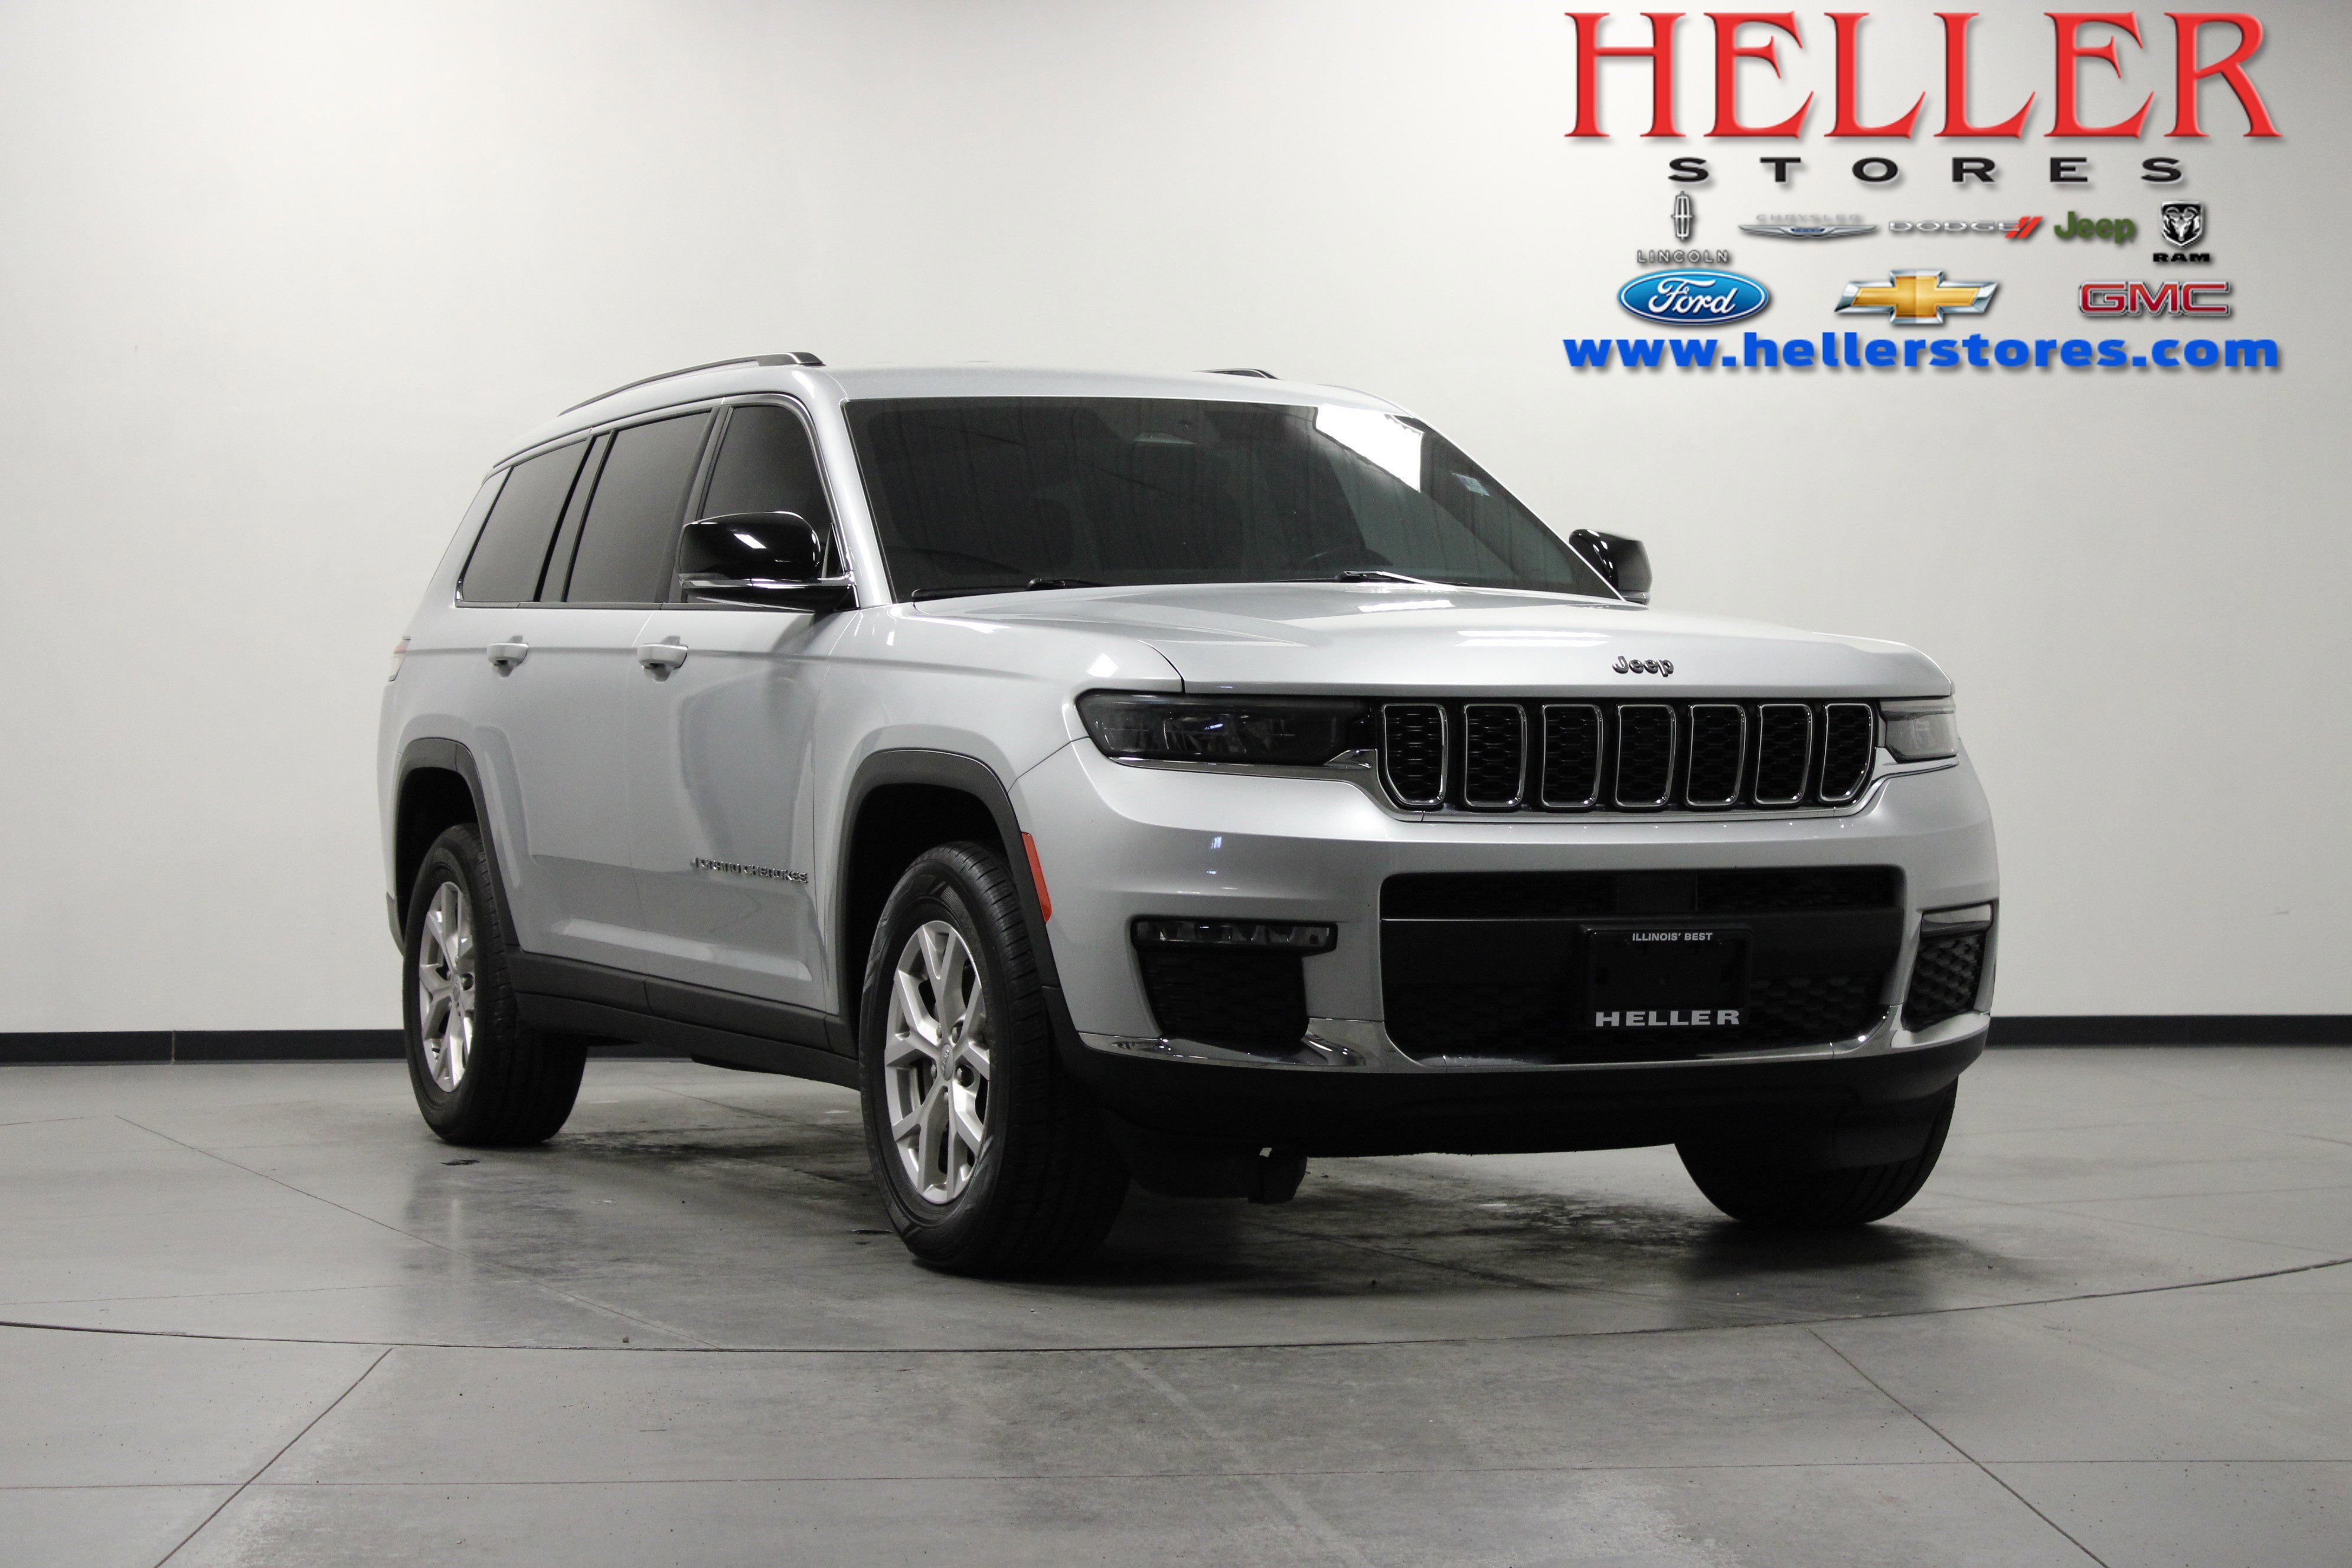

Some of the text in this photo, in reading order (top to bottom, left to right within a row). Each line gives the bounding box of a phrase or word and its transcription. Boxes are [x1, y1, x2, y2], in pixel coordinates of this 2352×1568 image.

[1612, 655, 1674, 677] Jeep
[1684, 933, 1713, 941] BEST
[1595, 1010, 1739, 1027] HELLER
